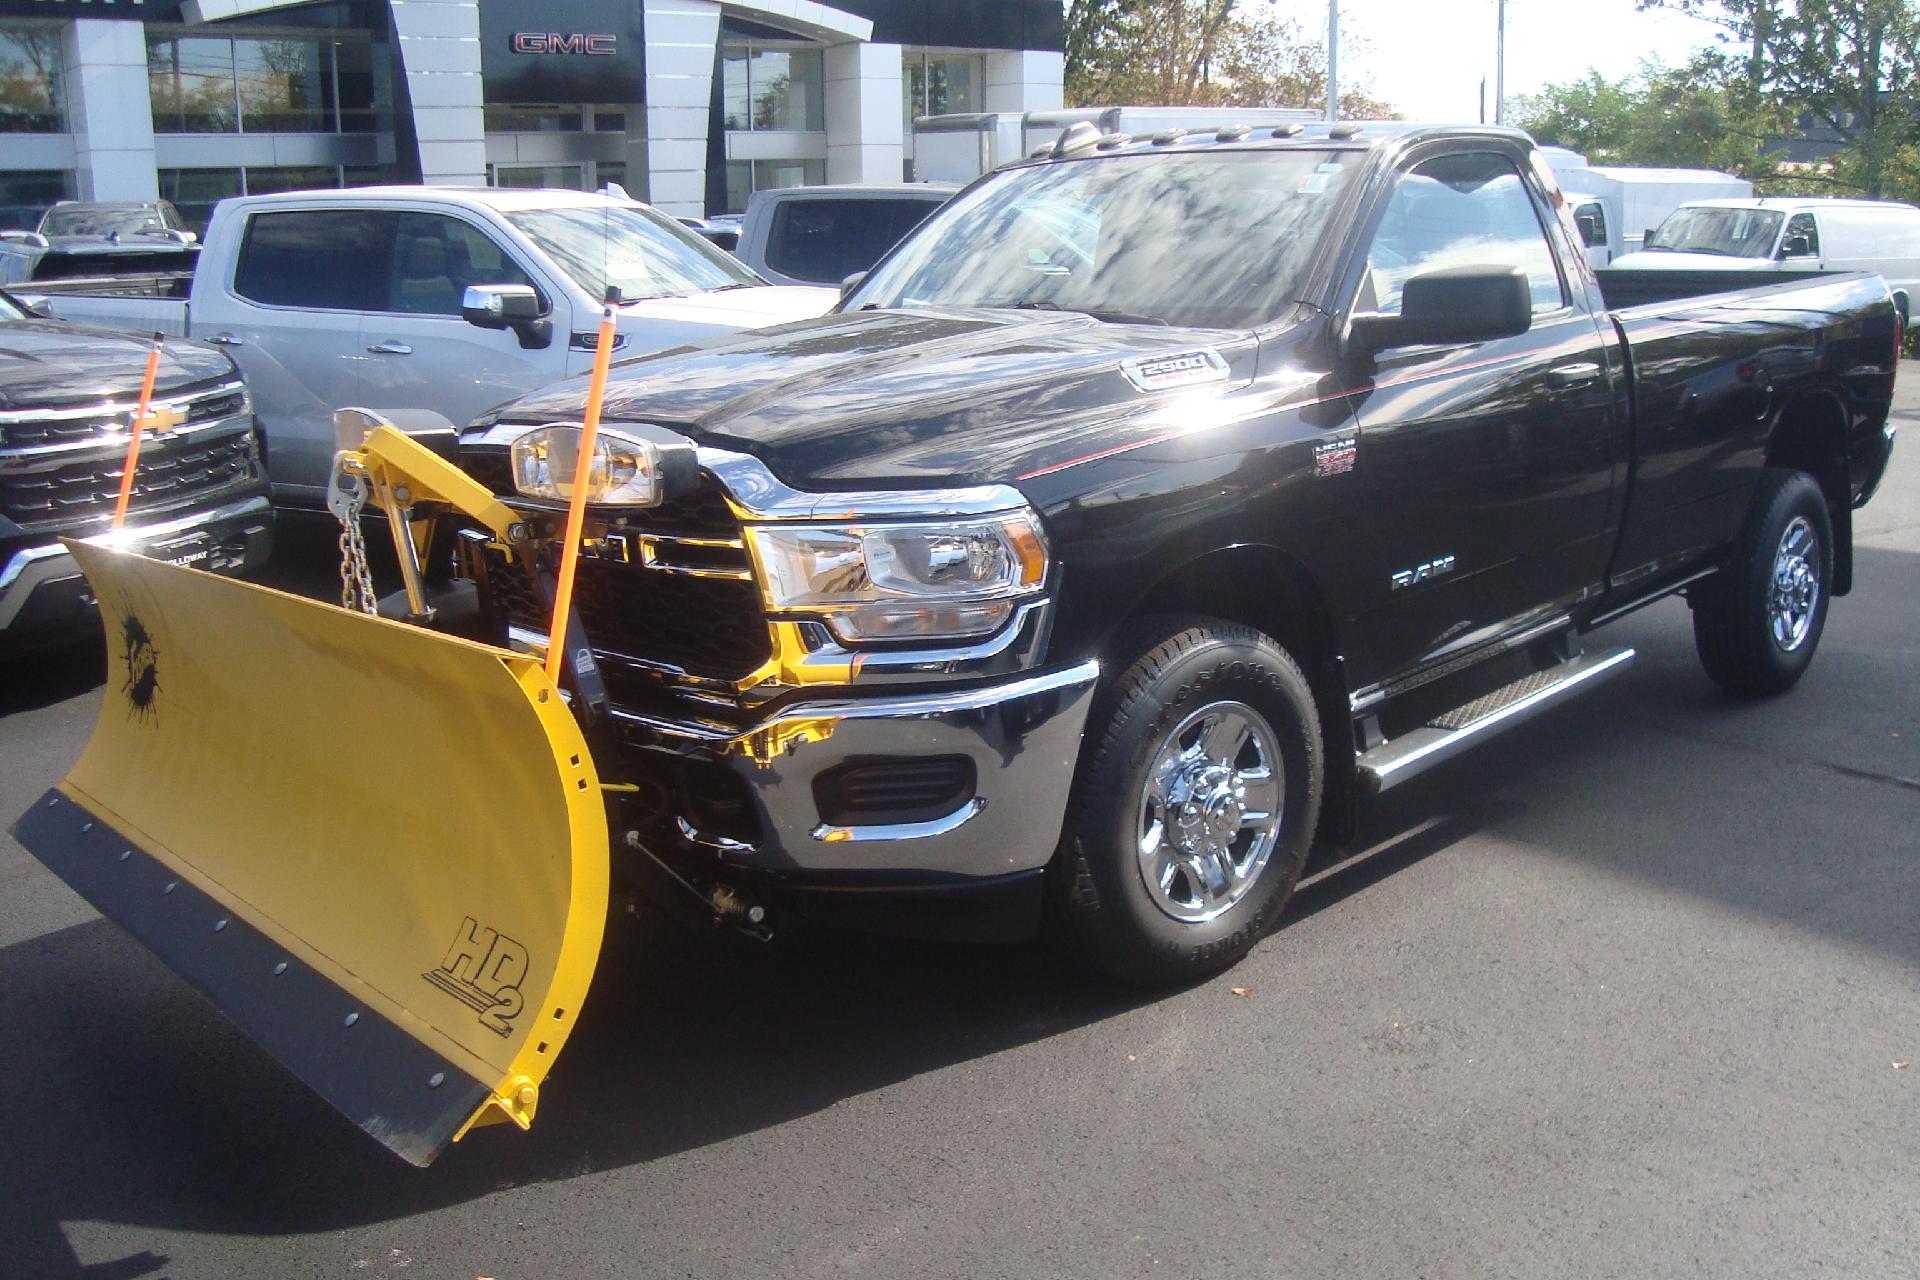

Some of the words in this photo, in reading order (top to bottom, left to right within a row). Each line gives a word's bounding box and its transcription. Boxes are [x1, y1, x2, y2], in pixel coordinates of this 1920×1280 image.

[514, 32, 617, 55] GMC
[1142, 355, 1206, 376] 2500
[1392, 556, 1455, 591] RAM
